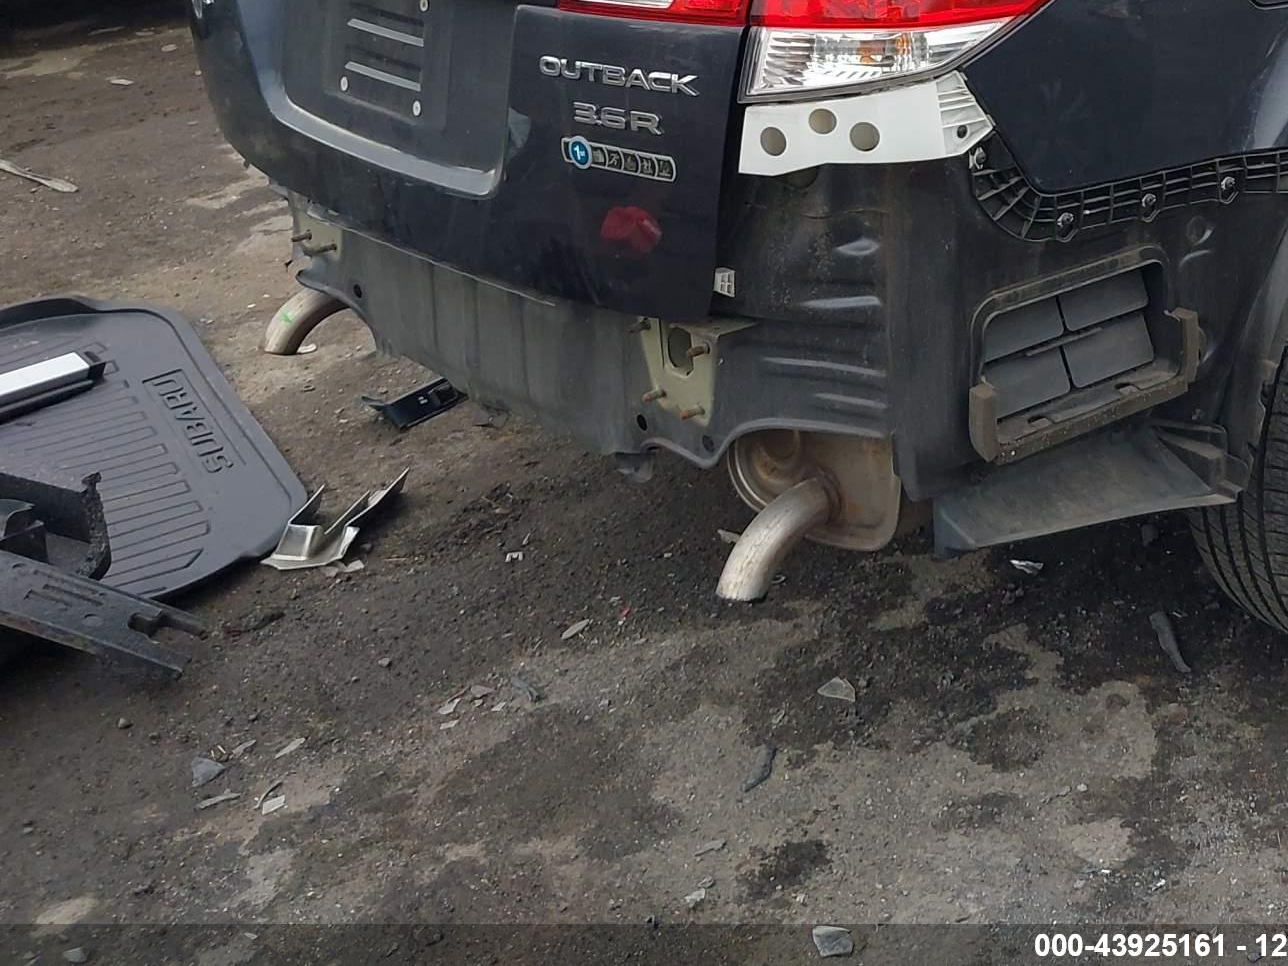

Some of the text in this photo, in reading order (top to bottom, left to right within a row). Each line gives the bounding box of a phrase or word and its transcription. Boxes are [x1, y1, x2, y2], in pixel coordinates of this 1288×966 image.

[539, 55, 701, 97] OUTBACK
[573, 101, 664, 135] 3.6R
[151, 378, 235, 474] SUBARU
